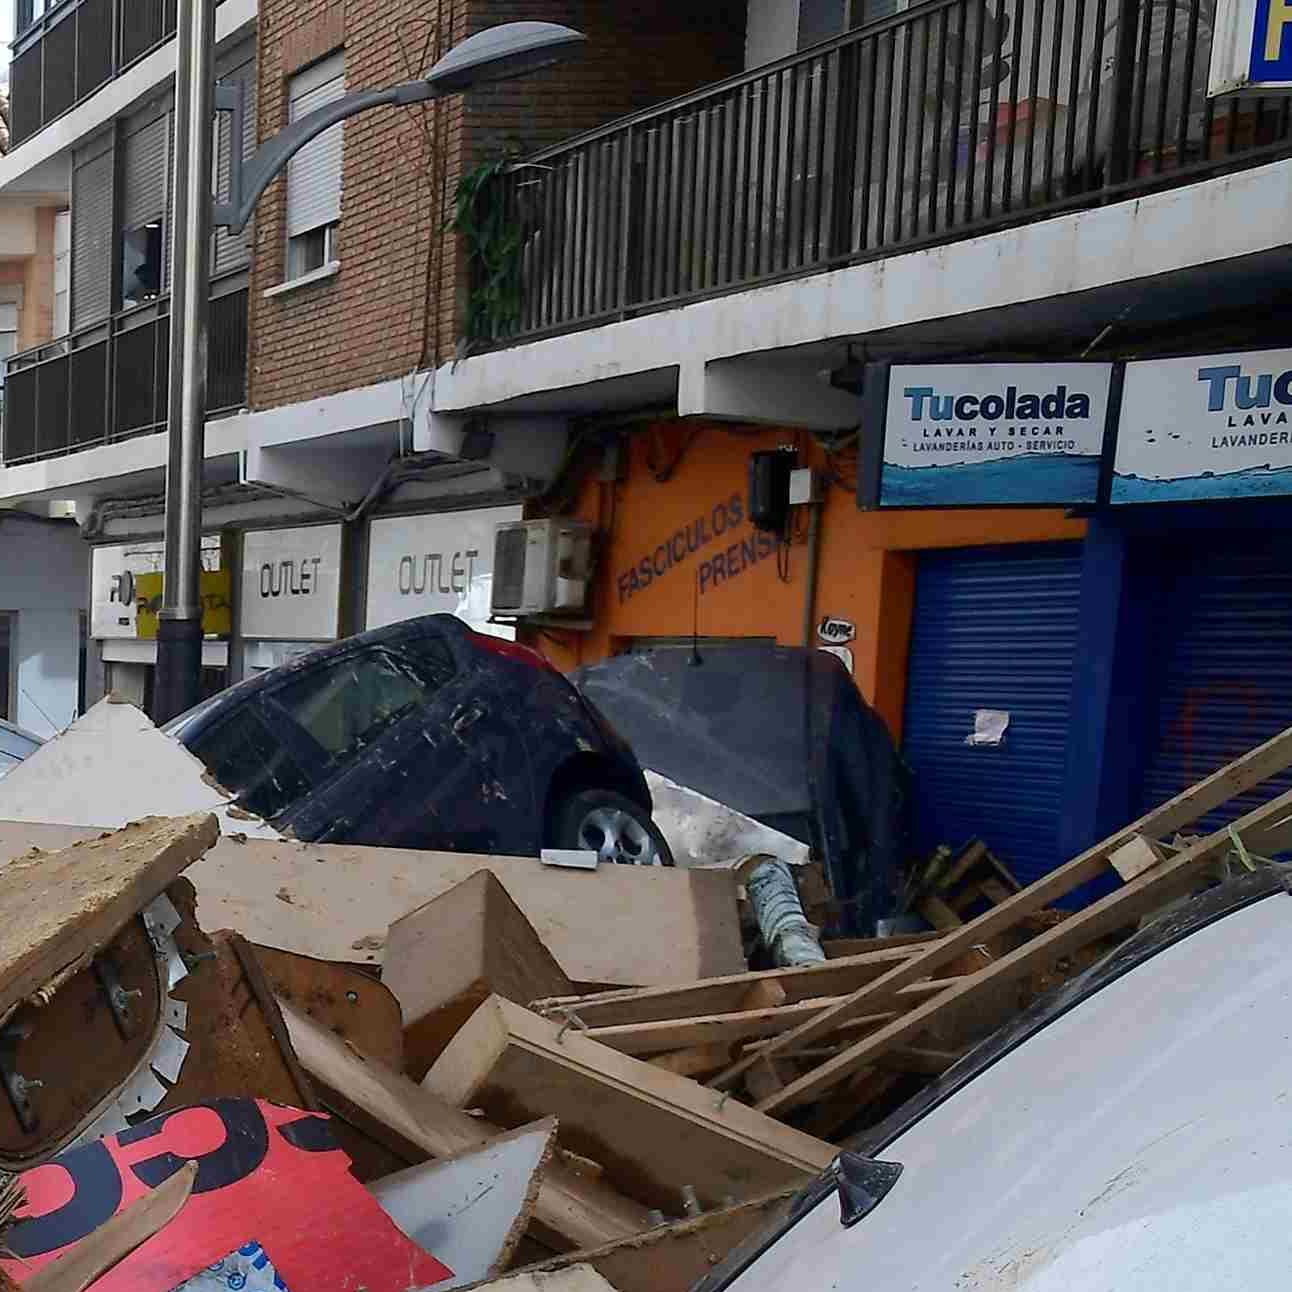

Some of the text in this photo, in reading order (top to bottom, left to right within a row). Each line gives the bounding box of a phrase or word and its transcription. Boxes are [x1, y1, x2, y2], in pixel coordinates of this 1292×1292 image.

[904, 386, 1090, 421] Tucolada
[923, 426, 1064, 438] LAVAR Y SECAR
[987, 440, 1015, 450] AUTO
[1026, 439, 1075, 450] SERVICIO
[1212, 432, 1292, 448] LAVANDER
[260, 558, 321, 598] OUTLET
[399, 549, 478, 596] OUTLET
